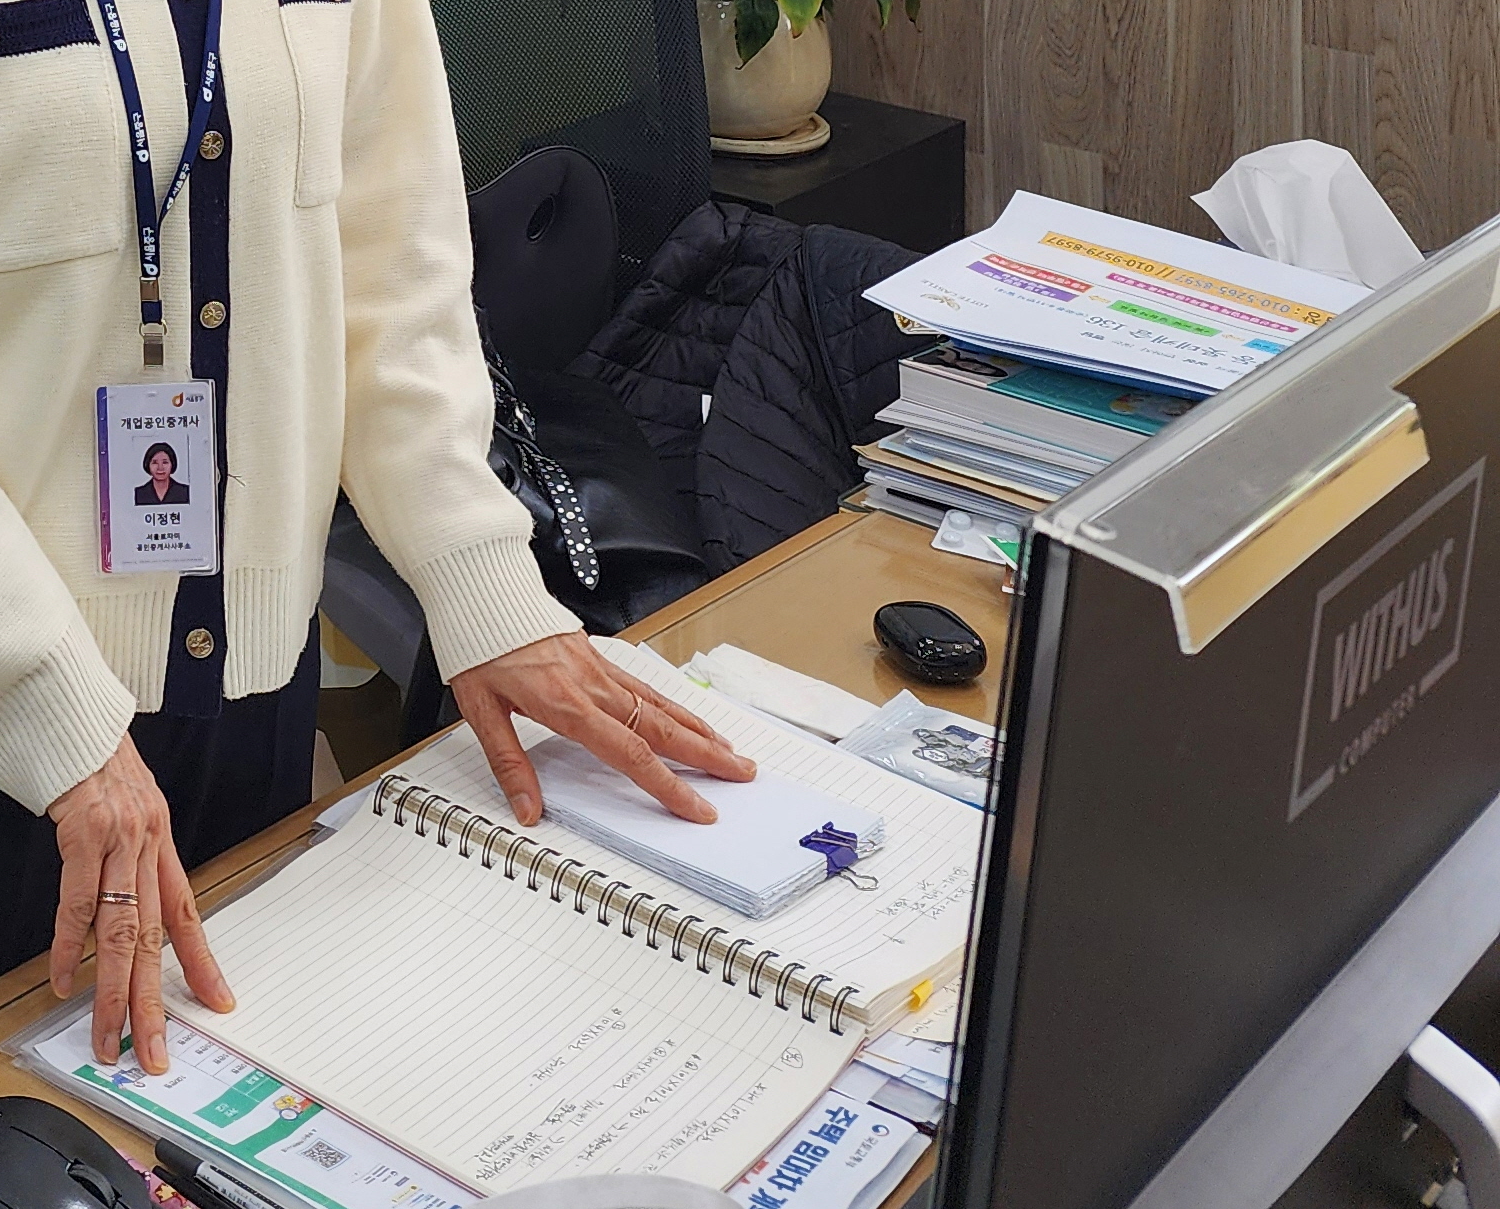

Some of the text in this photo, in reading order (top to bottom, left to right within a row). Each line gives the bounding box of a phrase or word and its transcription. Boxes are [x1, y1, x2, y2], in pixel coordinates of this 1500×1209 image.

[1046, 234, 1155, 273] 010-9579-8597
[121, 415, 200, 430] 개업공인중개사
[144, 512, 181, 526] 이정현
[1331, 537, 1456, 722] WITHUS
[767, 1106, 860, 1192] 주택 임대차
